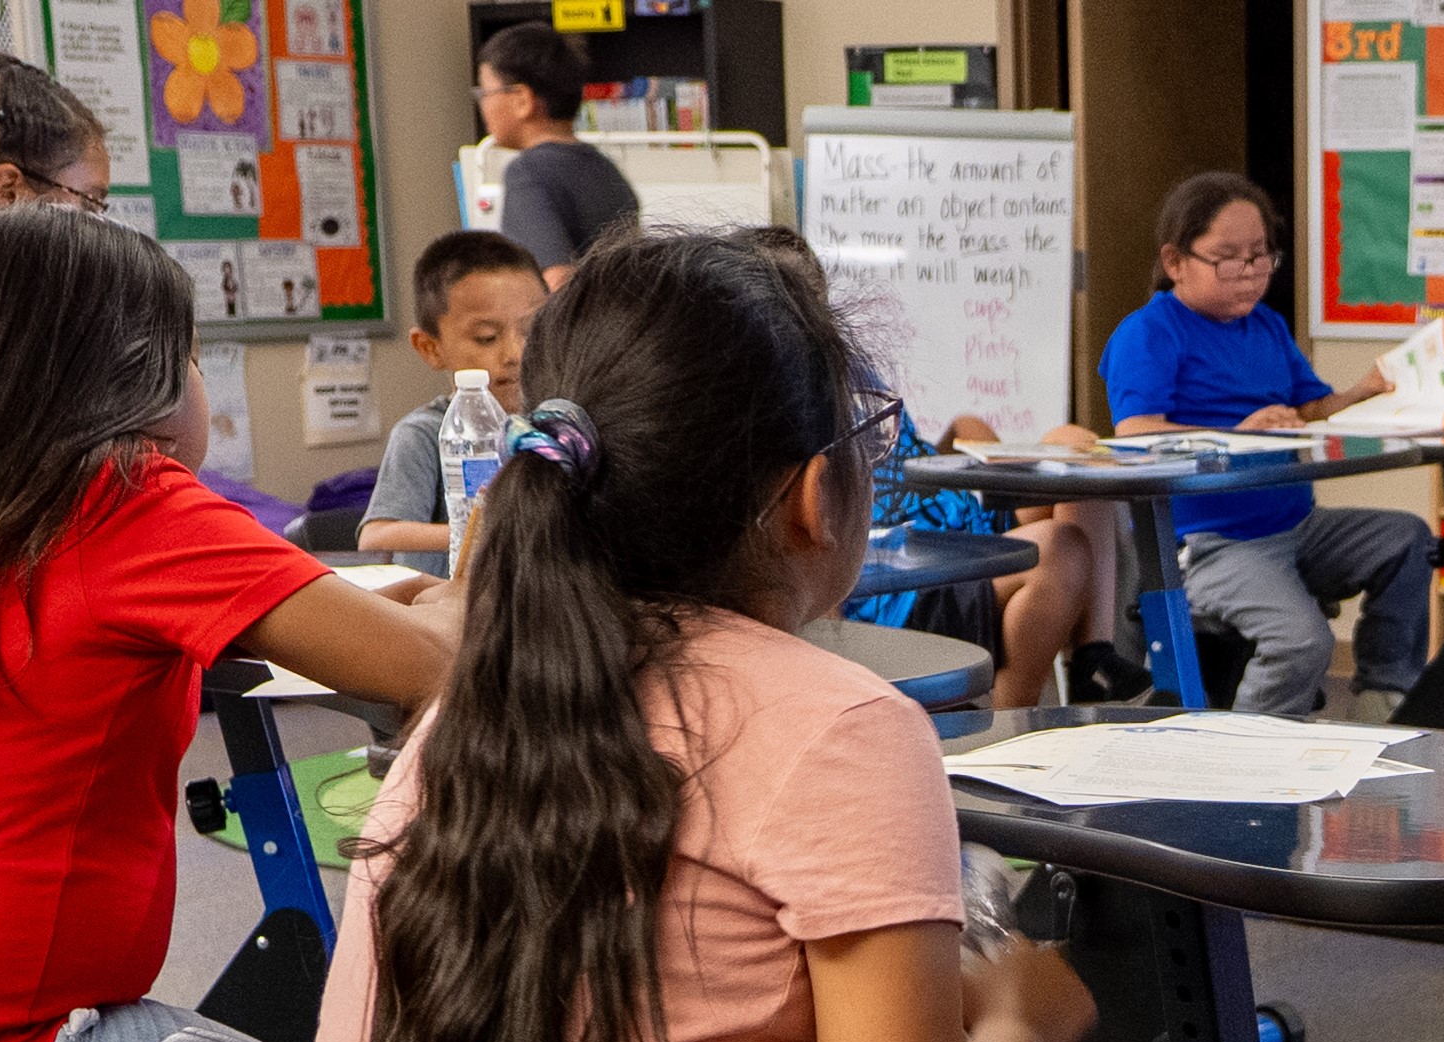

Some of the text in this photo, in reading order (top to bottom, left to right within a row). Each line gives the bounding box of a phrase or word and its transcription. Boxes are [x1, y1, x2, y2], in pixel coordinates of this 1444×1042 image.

[1326, 21, 1403, 61] 3rd
[908, 146, 936, 184] the
[950, 153, 1023, 181] amount
[1036, 149, 1061, 179] of
[940, 192, 996, 231] object
[918, 224, 945, 250] the
[959, 232, 1009, 252] mass
[1024, 226, 1058, 251] the
[917, 257, 957, 282] will
